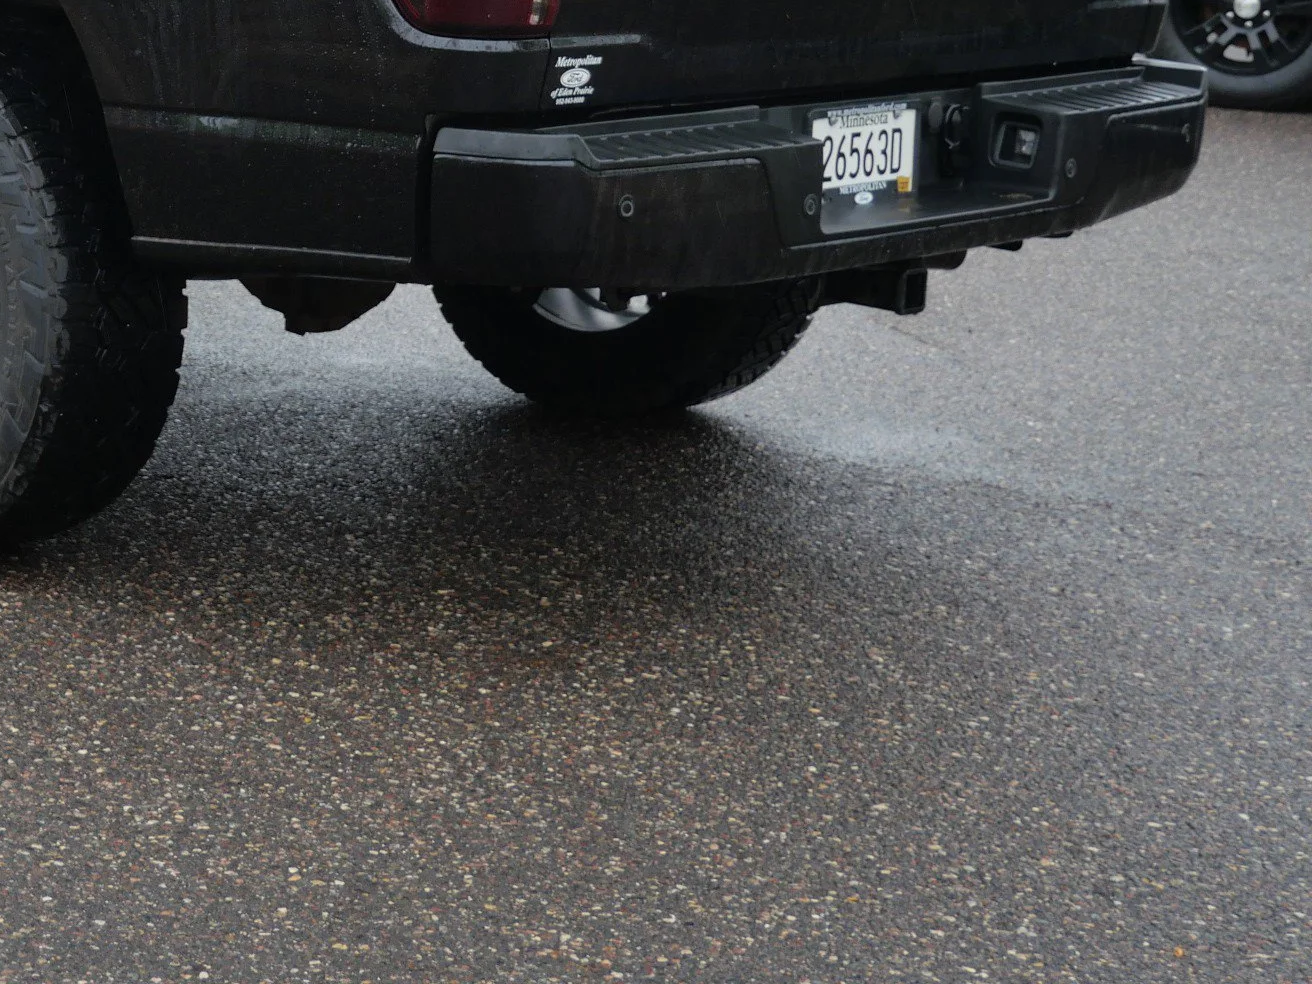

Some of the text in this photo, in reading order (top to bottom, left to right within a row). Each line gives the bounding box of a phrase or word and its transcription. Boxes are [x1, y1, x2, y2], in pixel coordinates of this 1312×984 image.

[555, 54, 602, 68] Metropolitan
[840, 113, 889, 129] Minnesota
[823, 128, 903, 183] 26563D
